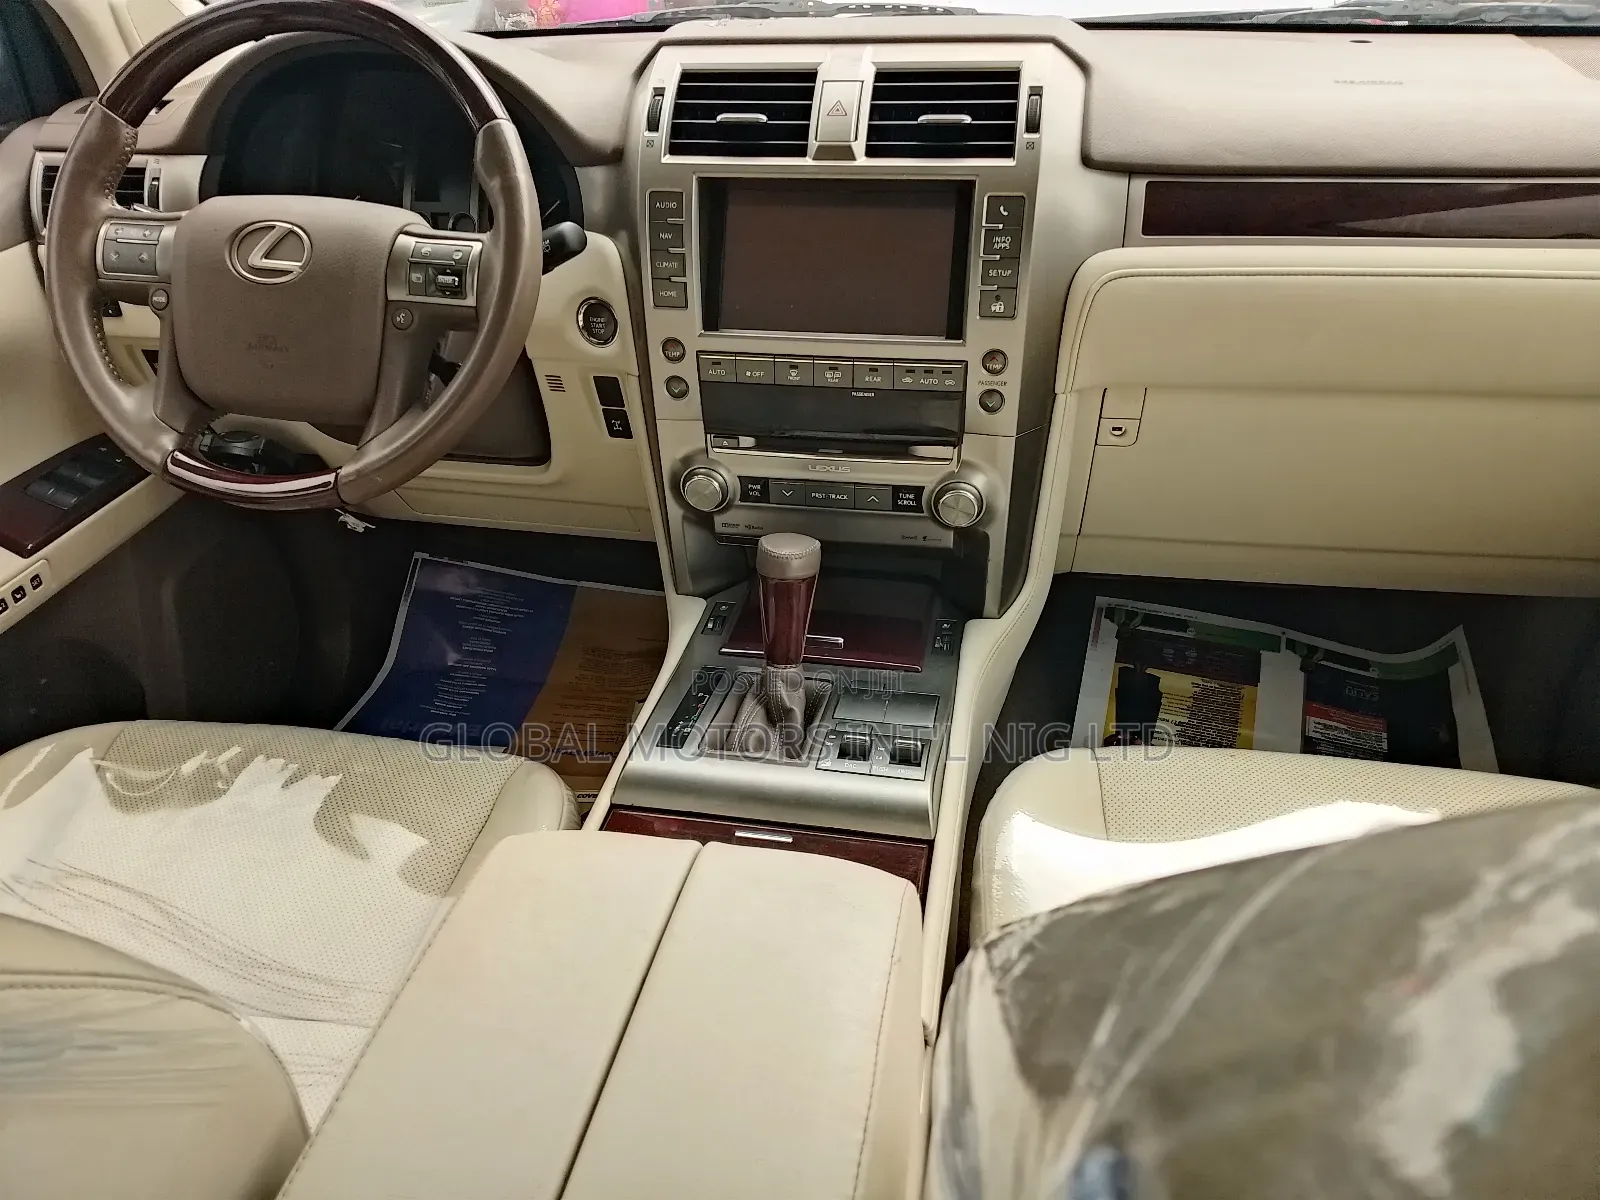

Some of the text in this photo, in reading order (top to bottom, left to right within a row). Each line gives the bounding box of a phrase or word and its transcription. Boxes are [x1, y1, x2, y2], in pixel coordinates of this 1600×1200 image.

[993, 236, 1012, 244] INFO
[655, 261, 678, 269] CLIMATE
[988, 269, 1012, 277] SETUP
[665, 350, 681, 358] TEMP
[864, 375, 882, 383] REAR
[978, 379, 1008, 387] PASSENGER
[808, 464, 851, 473] LEXUS
